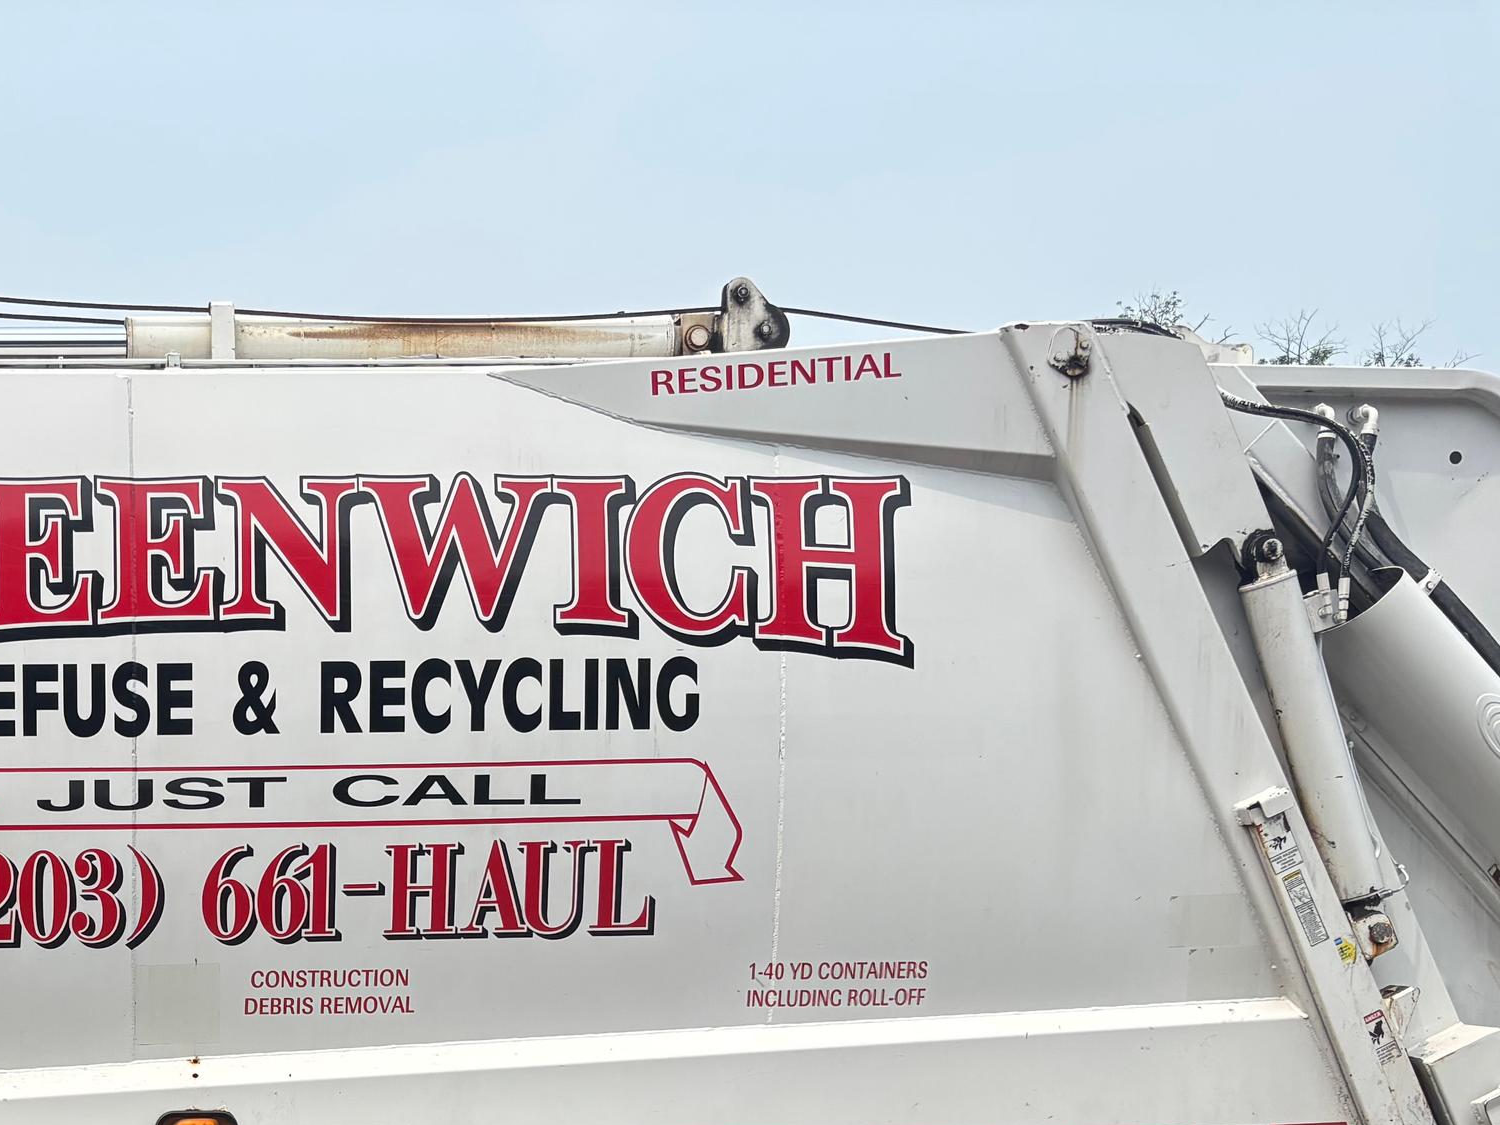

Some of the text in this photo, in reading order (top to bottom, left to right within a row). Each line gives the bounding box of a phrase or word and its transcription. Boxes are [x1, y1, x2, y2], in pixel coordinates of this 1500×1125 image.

[651, 352, 902, 397] RESIDENTIAL
[232, 661, 281, 737] &
[319, 657, 700, 735] RECYCLING
[36, 774, 582, 812] JUST CALL
[202, 839, 656, 944] 661-HAUL
[250, 968, 410, 989] CONSTRUCTION
[749, 960, 929, 980] 1-40 YD CONTAINERS
[244, 994, 415, 1016] DEBRIS REMOVAL
[746, 987, 926, 1008] INCLUDING ROLL-OFF
